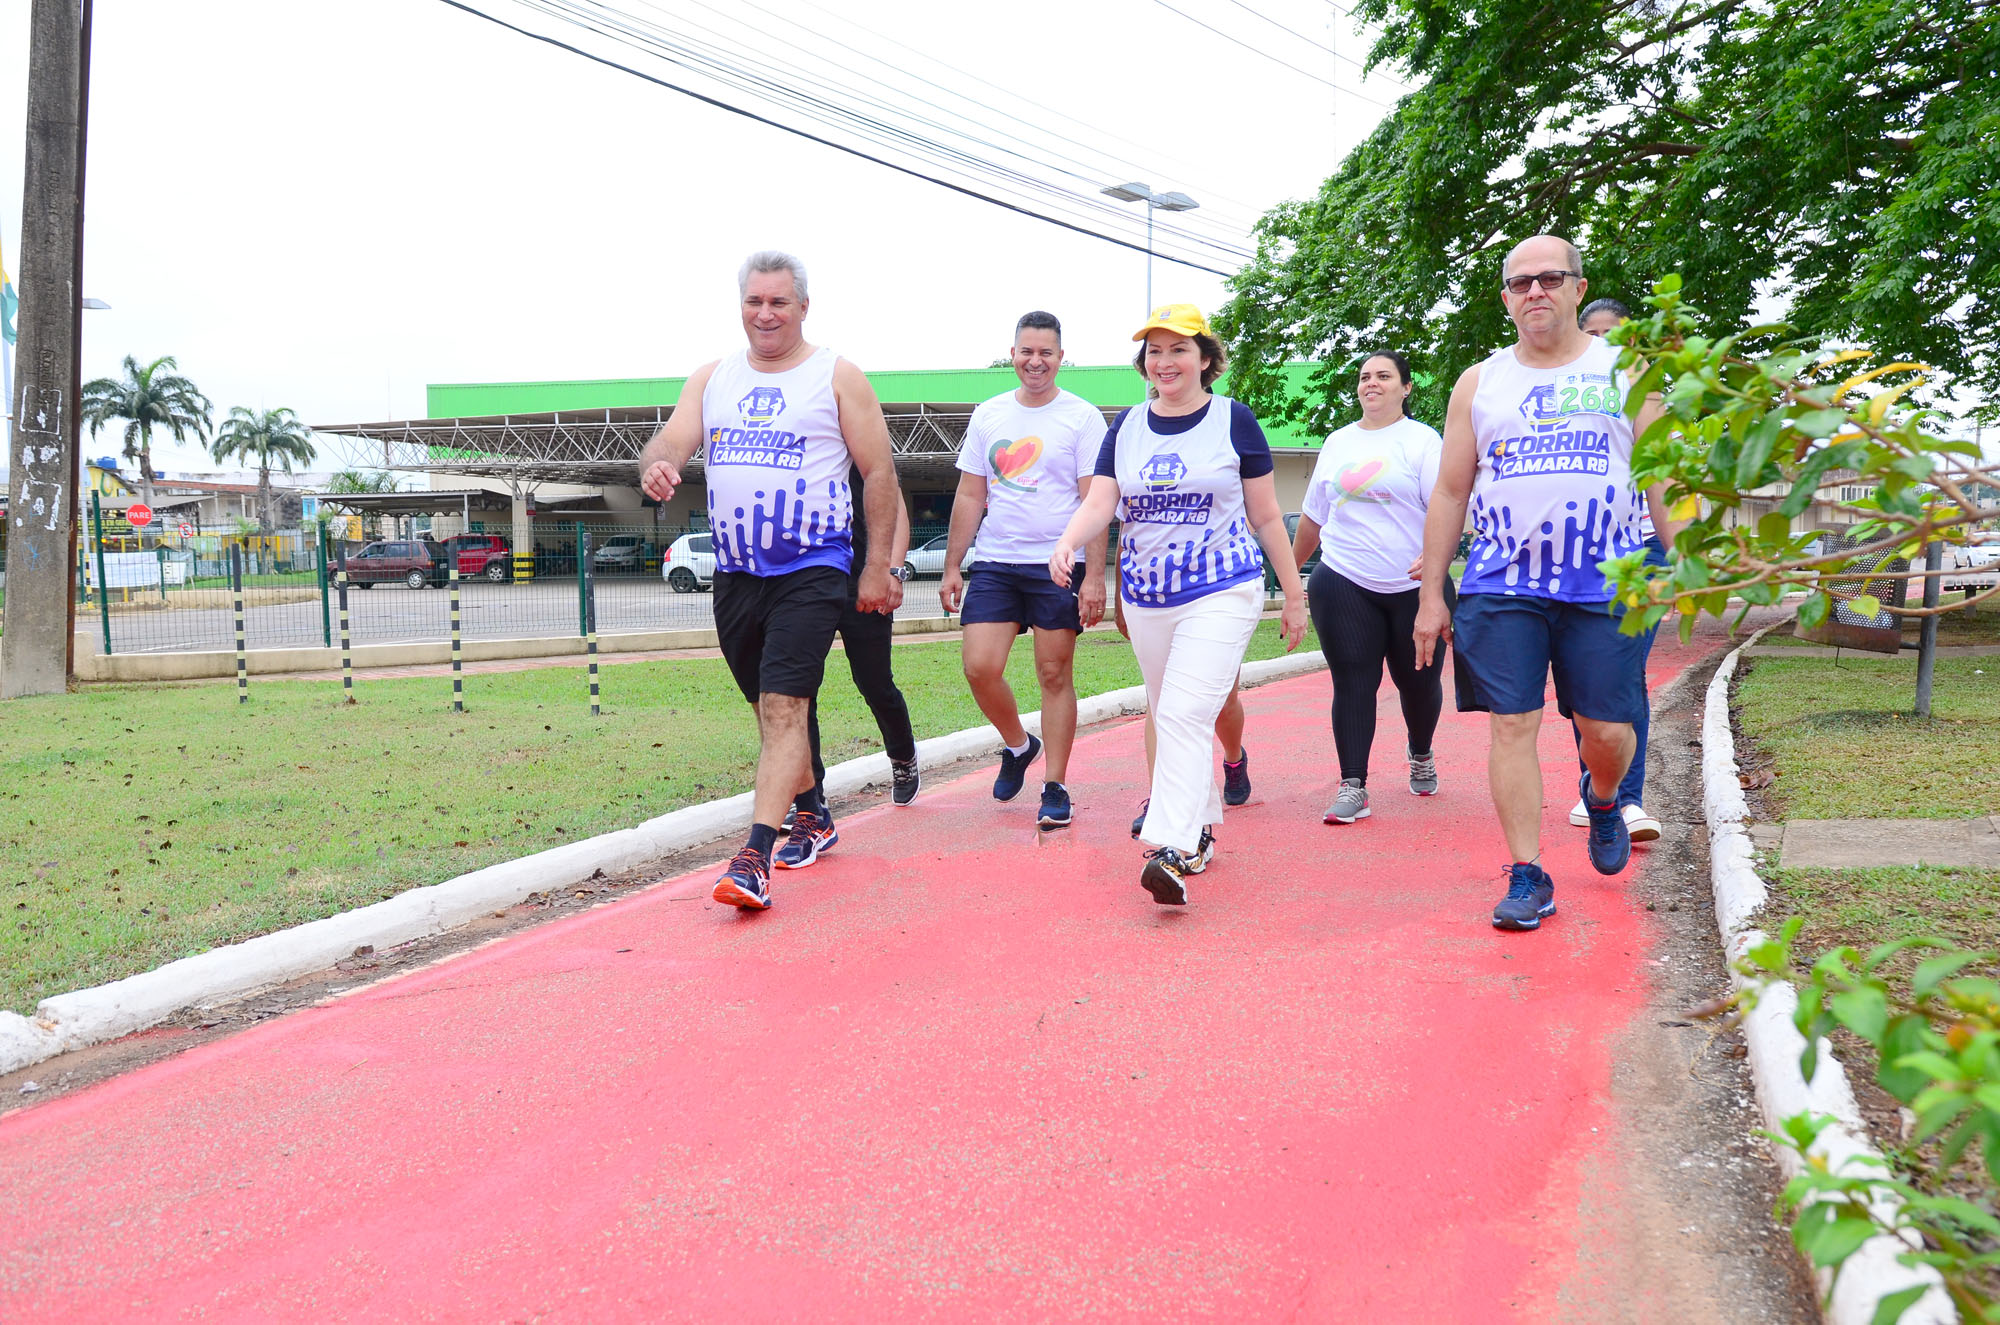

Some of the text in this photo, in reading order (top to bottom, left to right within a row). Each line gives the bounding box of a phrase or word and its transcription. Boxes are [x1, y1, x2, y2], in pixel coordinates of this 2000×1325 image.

[1560, 386, 1620, 414] 268
[719, 427, 807, 452] CORRIDA
[1504, 430, 1610, 457] CORRIDA
[714, 446, 801, 468] CÂMARA RB
[1502, 455, 1608, 476] CÂMARA RB
[1128, 493, 1213, 509] CORRIDA
[128, 511, 150, 519] PARE
[1186, 511, 1208, 523] RB
